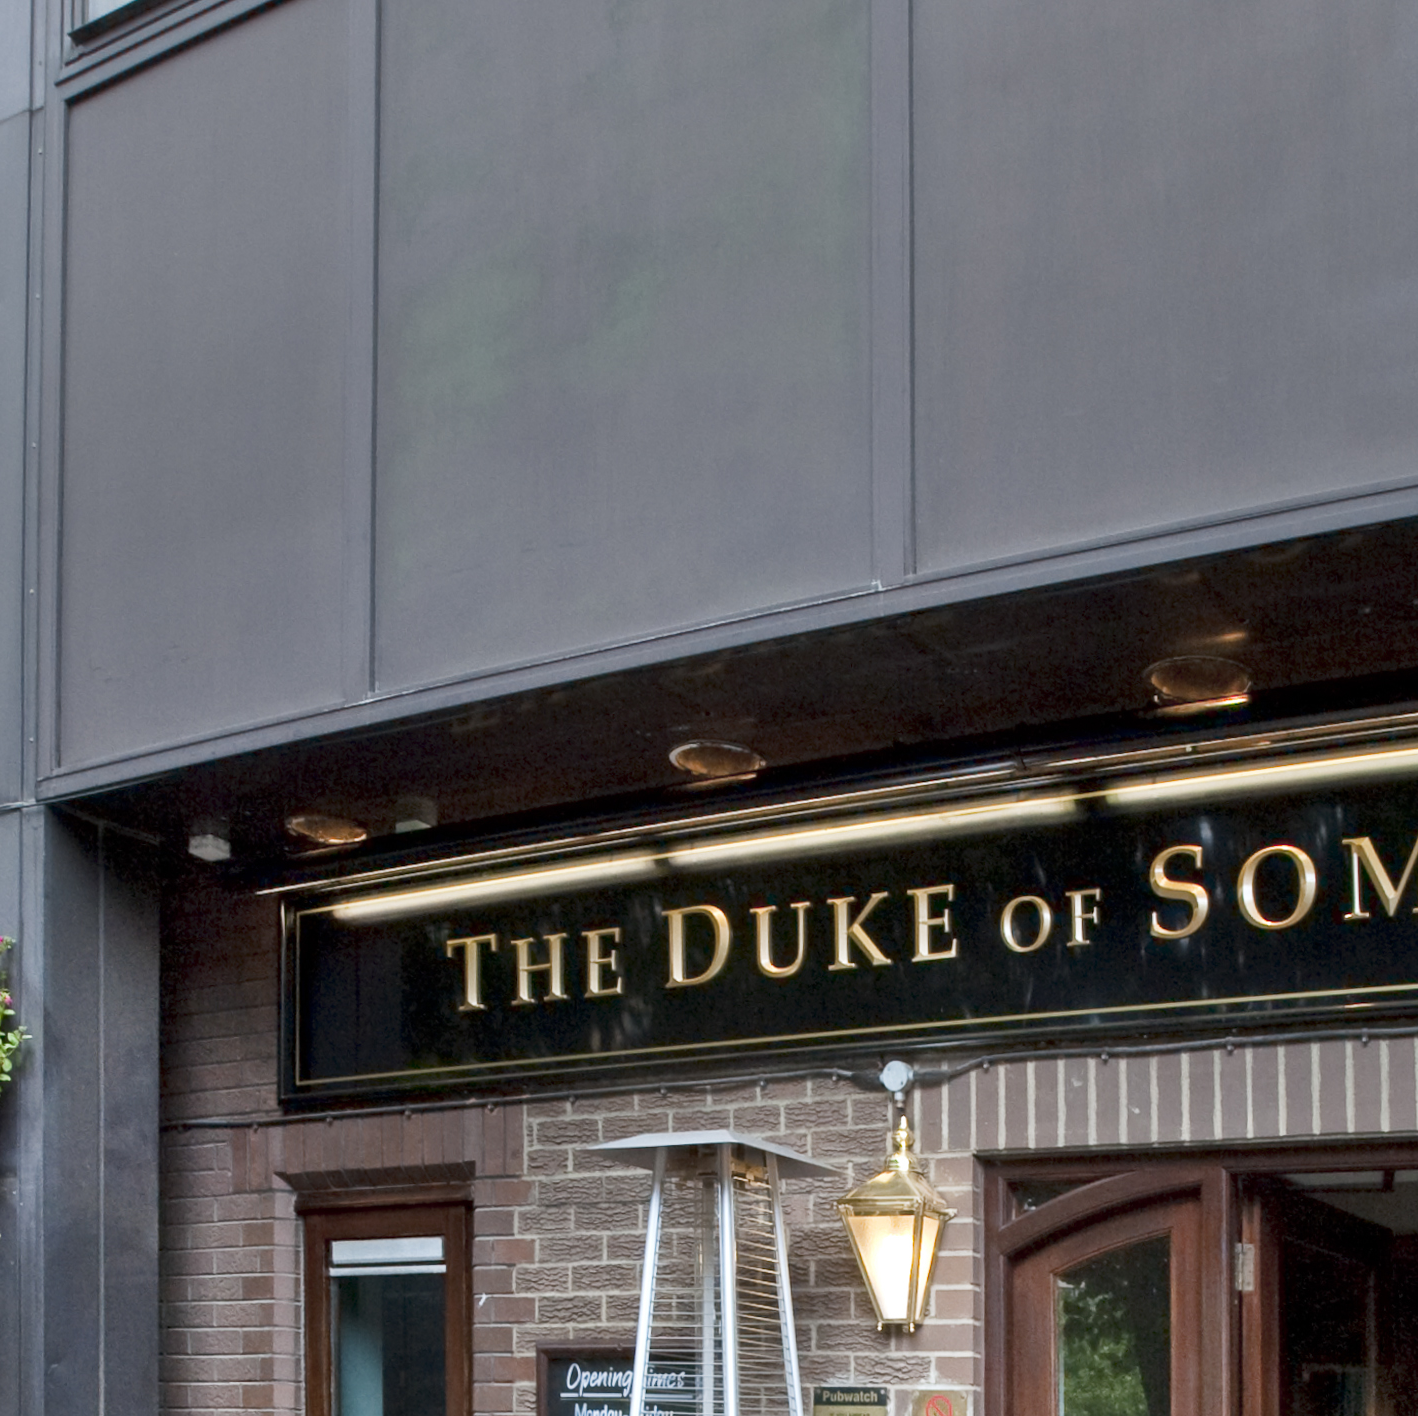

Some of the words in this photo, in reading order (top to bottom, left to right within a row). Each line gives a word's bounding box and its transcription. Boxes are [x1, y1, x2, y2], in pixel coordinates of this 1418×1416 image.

[446, 927, 623, 1012] THE
[661, 883, 958, 989] DUKE
[999, 887, 1101, 954] OF
[566, 1362, 634, 1398] Opening
[643, 1365, 686, 1389] imes
[822, 1390, 879, 1403] Pubwatch
